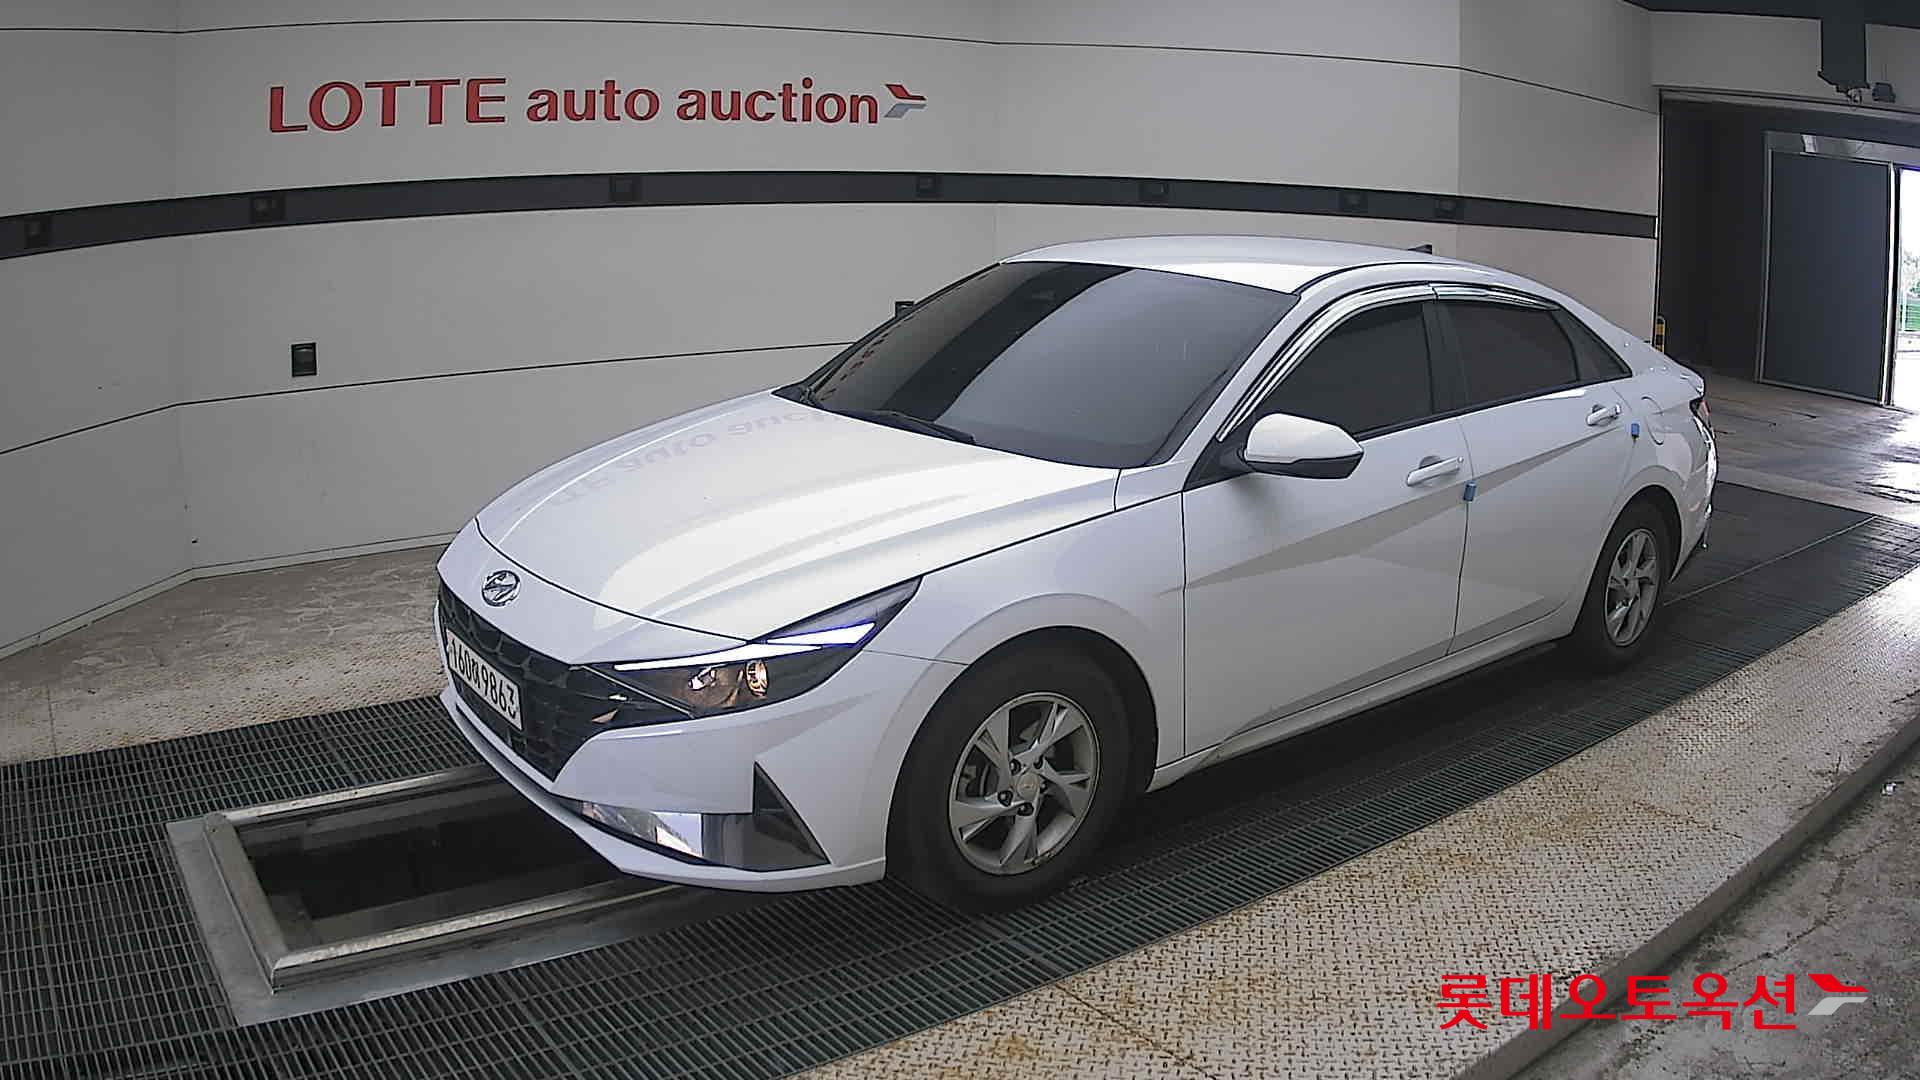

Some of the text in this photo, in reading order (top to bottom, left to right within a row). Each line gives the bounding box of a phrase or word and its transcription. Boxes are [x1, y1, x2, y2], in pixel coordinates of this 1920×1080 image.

[269, 77, 878, 133] LOTTE auto auction
